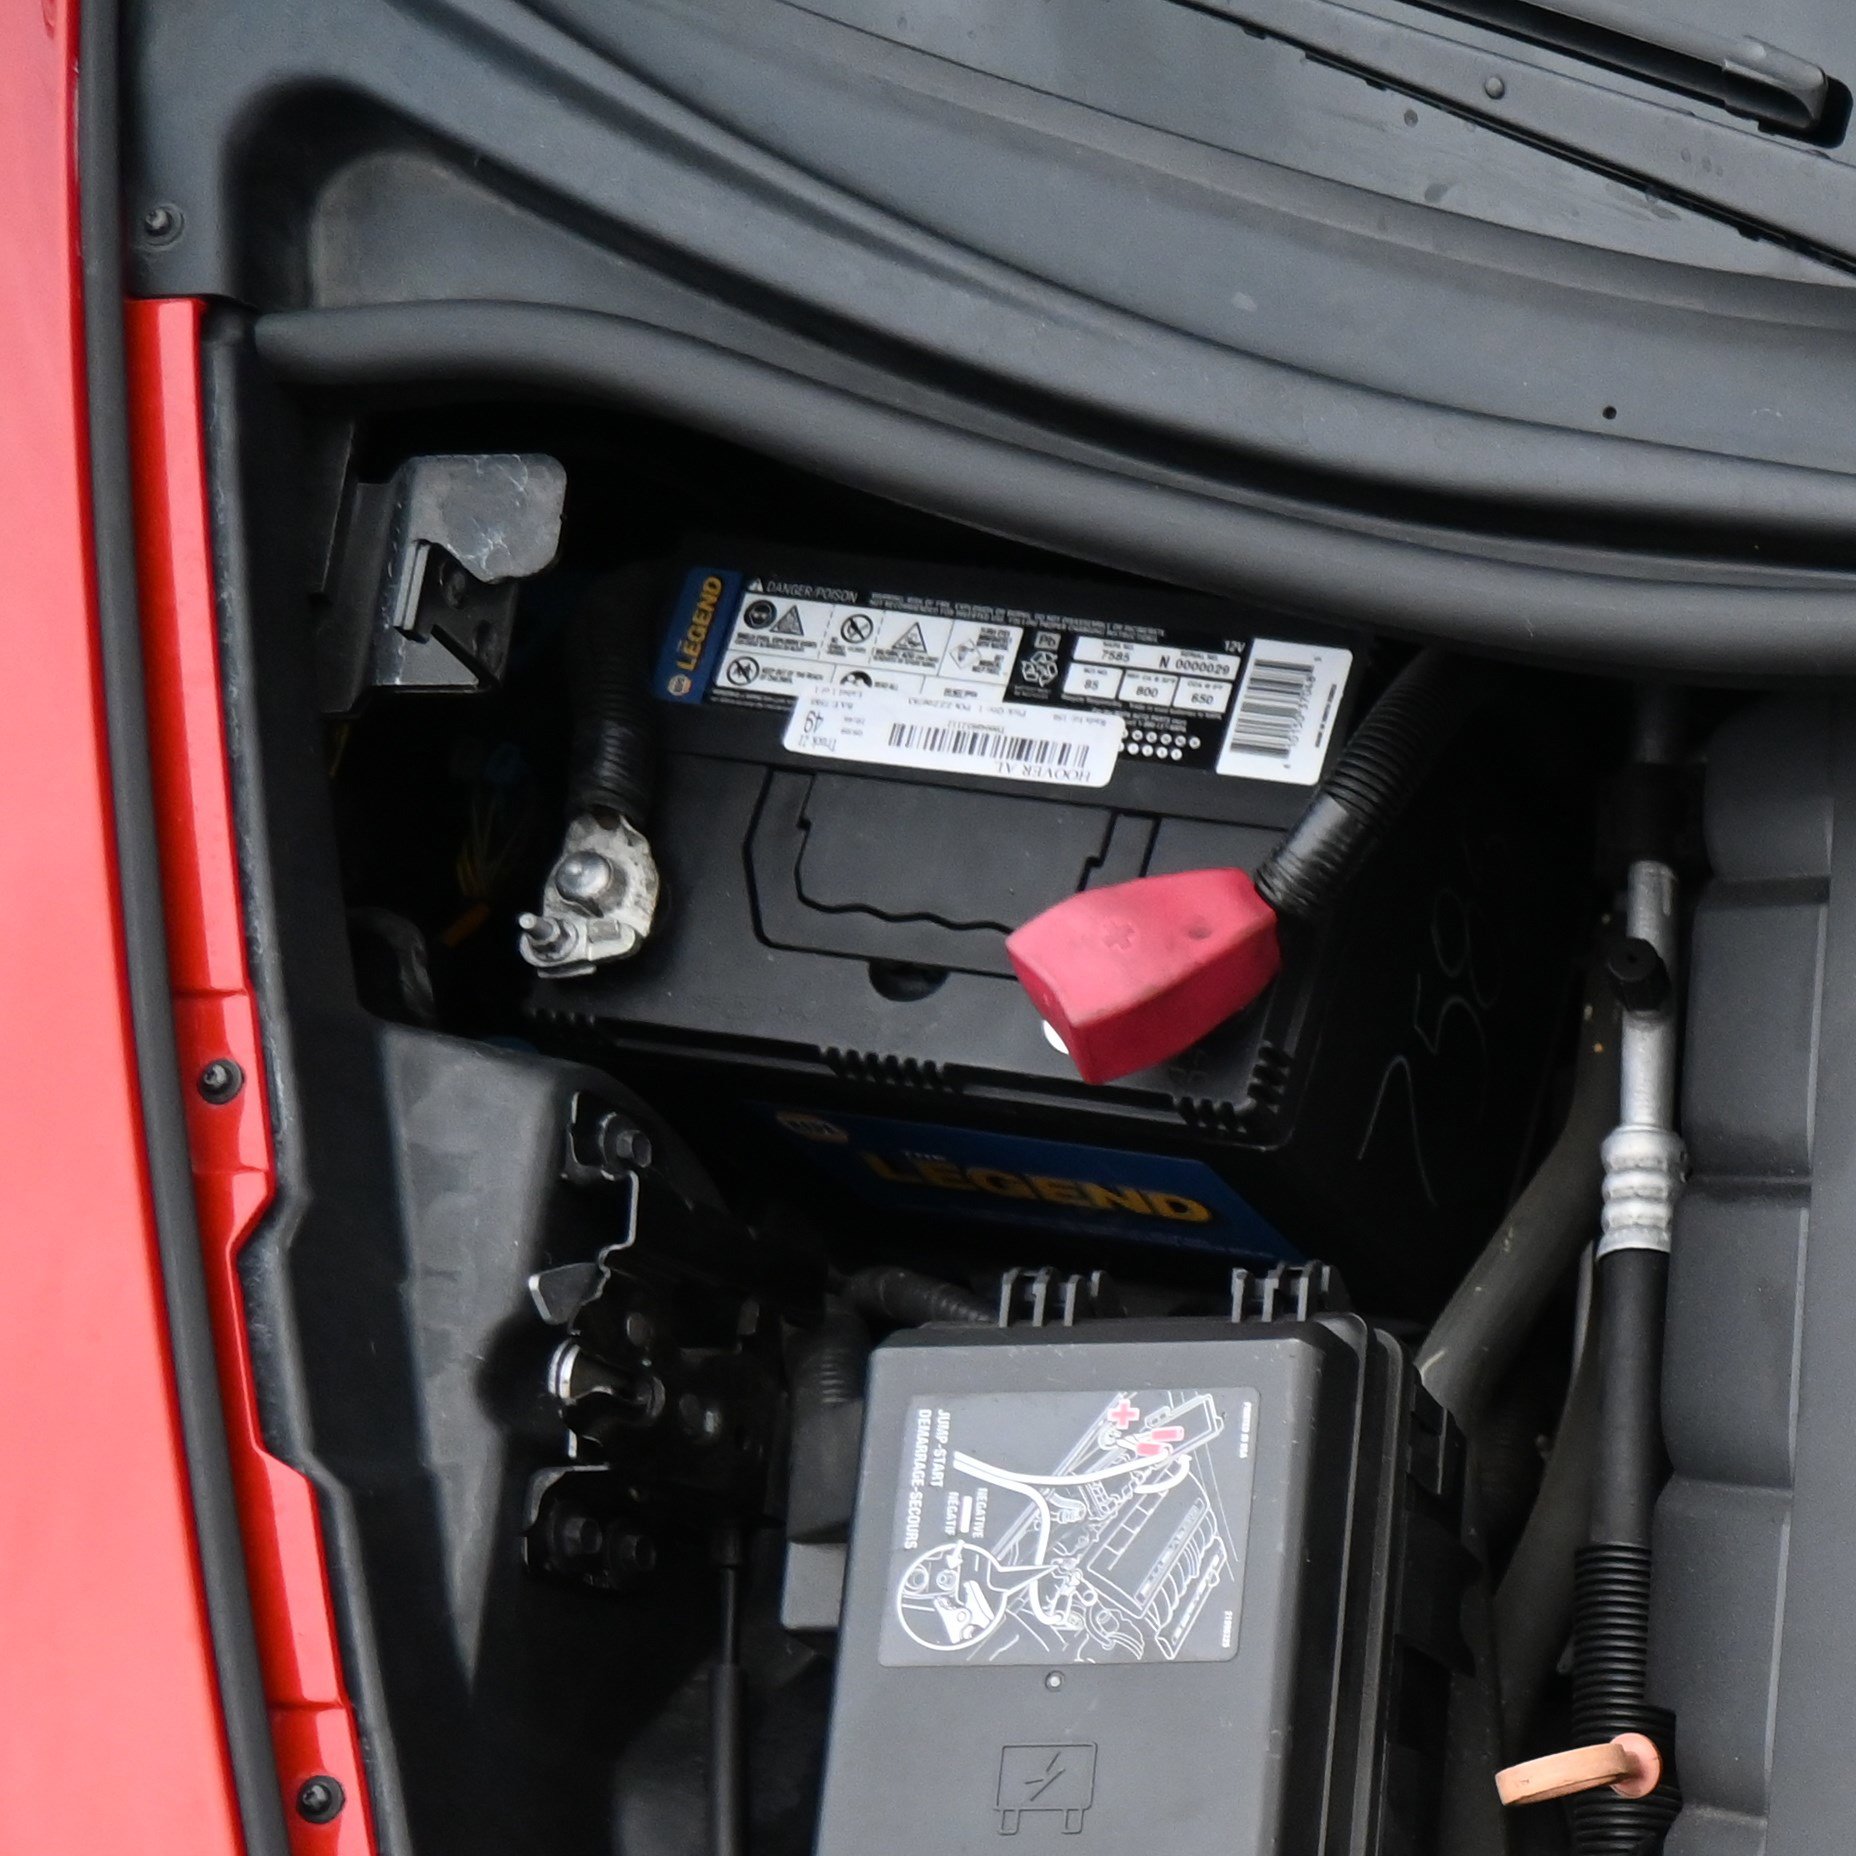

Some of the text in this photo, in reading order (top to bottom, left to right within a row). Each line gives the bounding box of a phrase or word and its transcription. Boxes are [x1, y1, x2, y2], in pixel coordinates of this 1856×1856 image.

[676, 575, 723, 671] LEGEND
[1224, 640, 1246, 653] 12V
[1101, 650, 1131, 663] 7585
[1159, 655, 1231, 675] N 0000029
[1084, 679, 1099, 691] 85
[1135, 685, 1159, 698] 800
[1191, 692, 1214, 705] 650
[804, 710, 824, 734] 49
[1022, 764, 1091, 782] HOOVER
[859, 1151, 1214, 1224] LEGEND
[930, 1409, 951, 1488] JUMP-START
[972, 1487, 988, 1538] NEGATIVE
